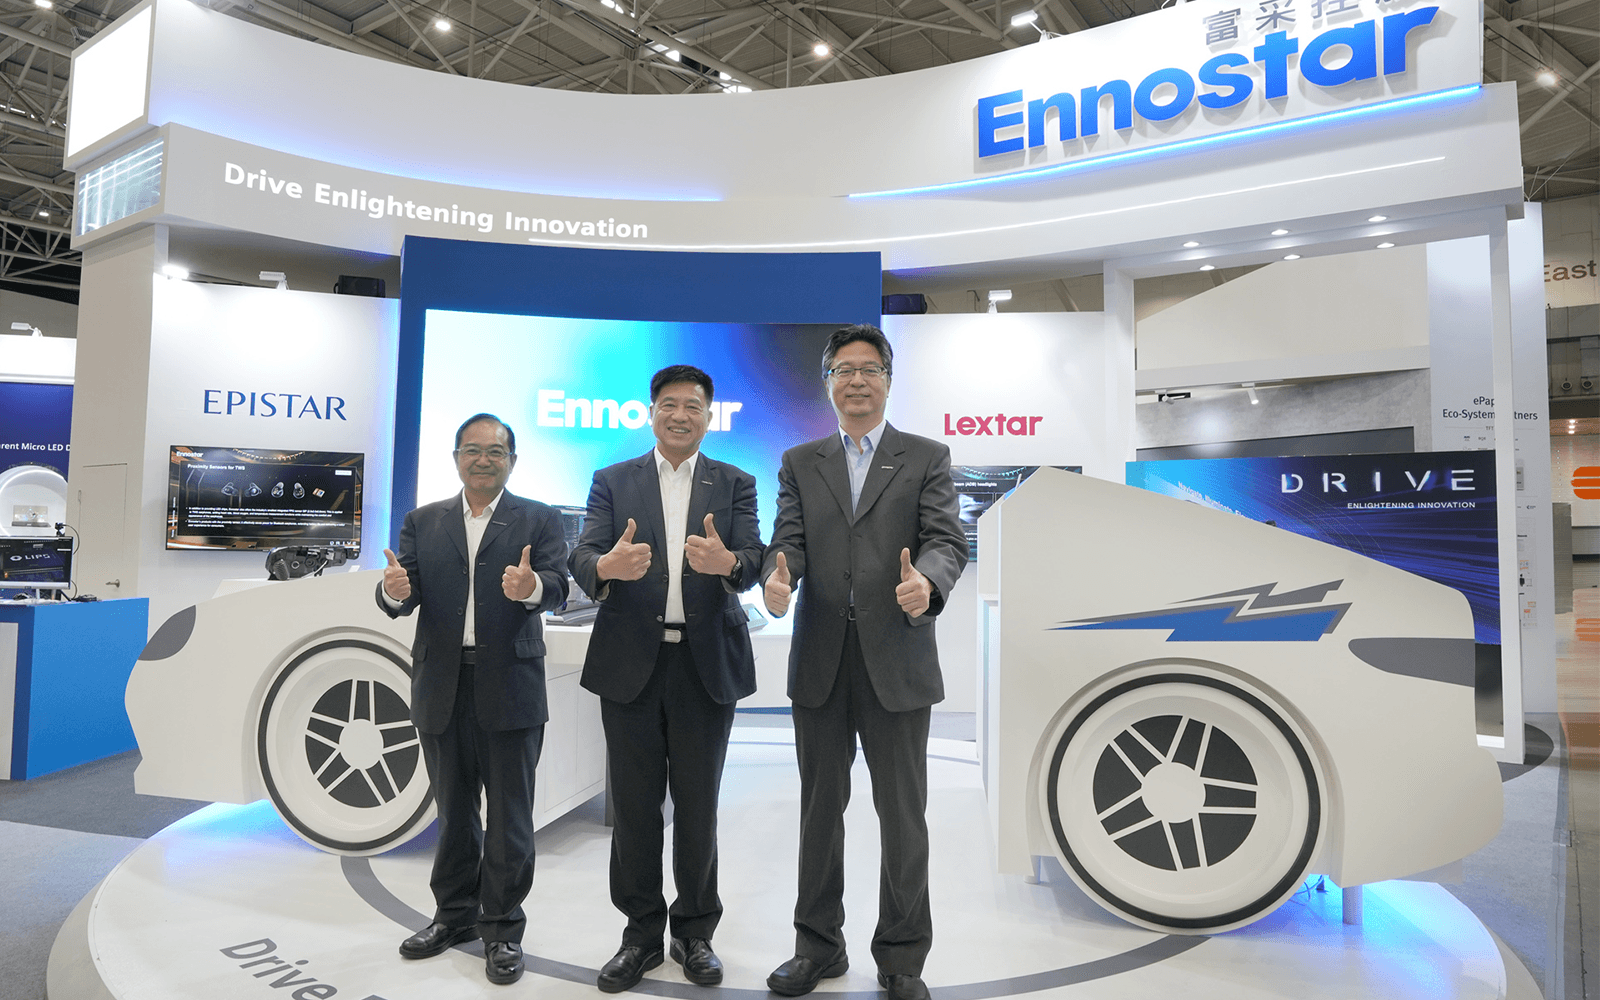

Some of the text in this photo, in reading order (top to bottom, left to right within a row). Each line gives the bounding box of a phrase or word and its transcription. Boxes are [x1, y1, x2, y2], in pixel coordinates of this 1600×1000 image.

[1202, 0, 1396, 46] 富采控
[978, 6, 1440, 159] Ennostar
[224, 161, 649, 239] Drive Enlightening Innovation
[203, 389, 348, 422] EPISTAR
[1513, 411, 1539, 420] tners
[944, 413, 1044, 436] Lextar
[0, 442, 20, 450] rent
[21, 442, 46, 451] Micro
[47, 443, 64, 451] LED
[1281, 469, 1476, 493] DRIVE
[1417, 501, 1476, 509] INNOVATION
[219, 937, 338, 1000] Drive
